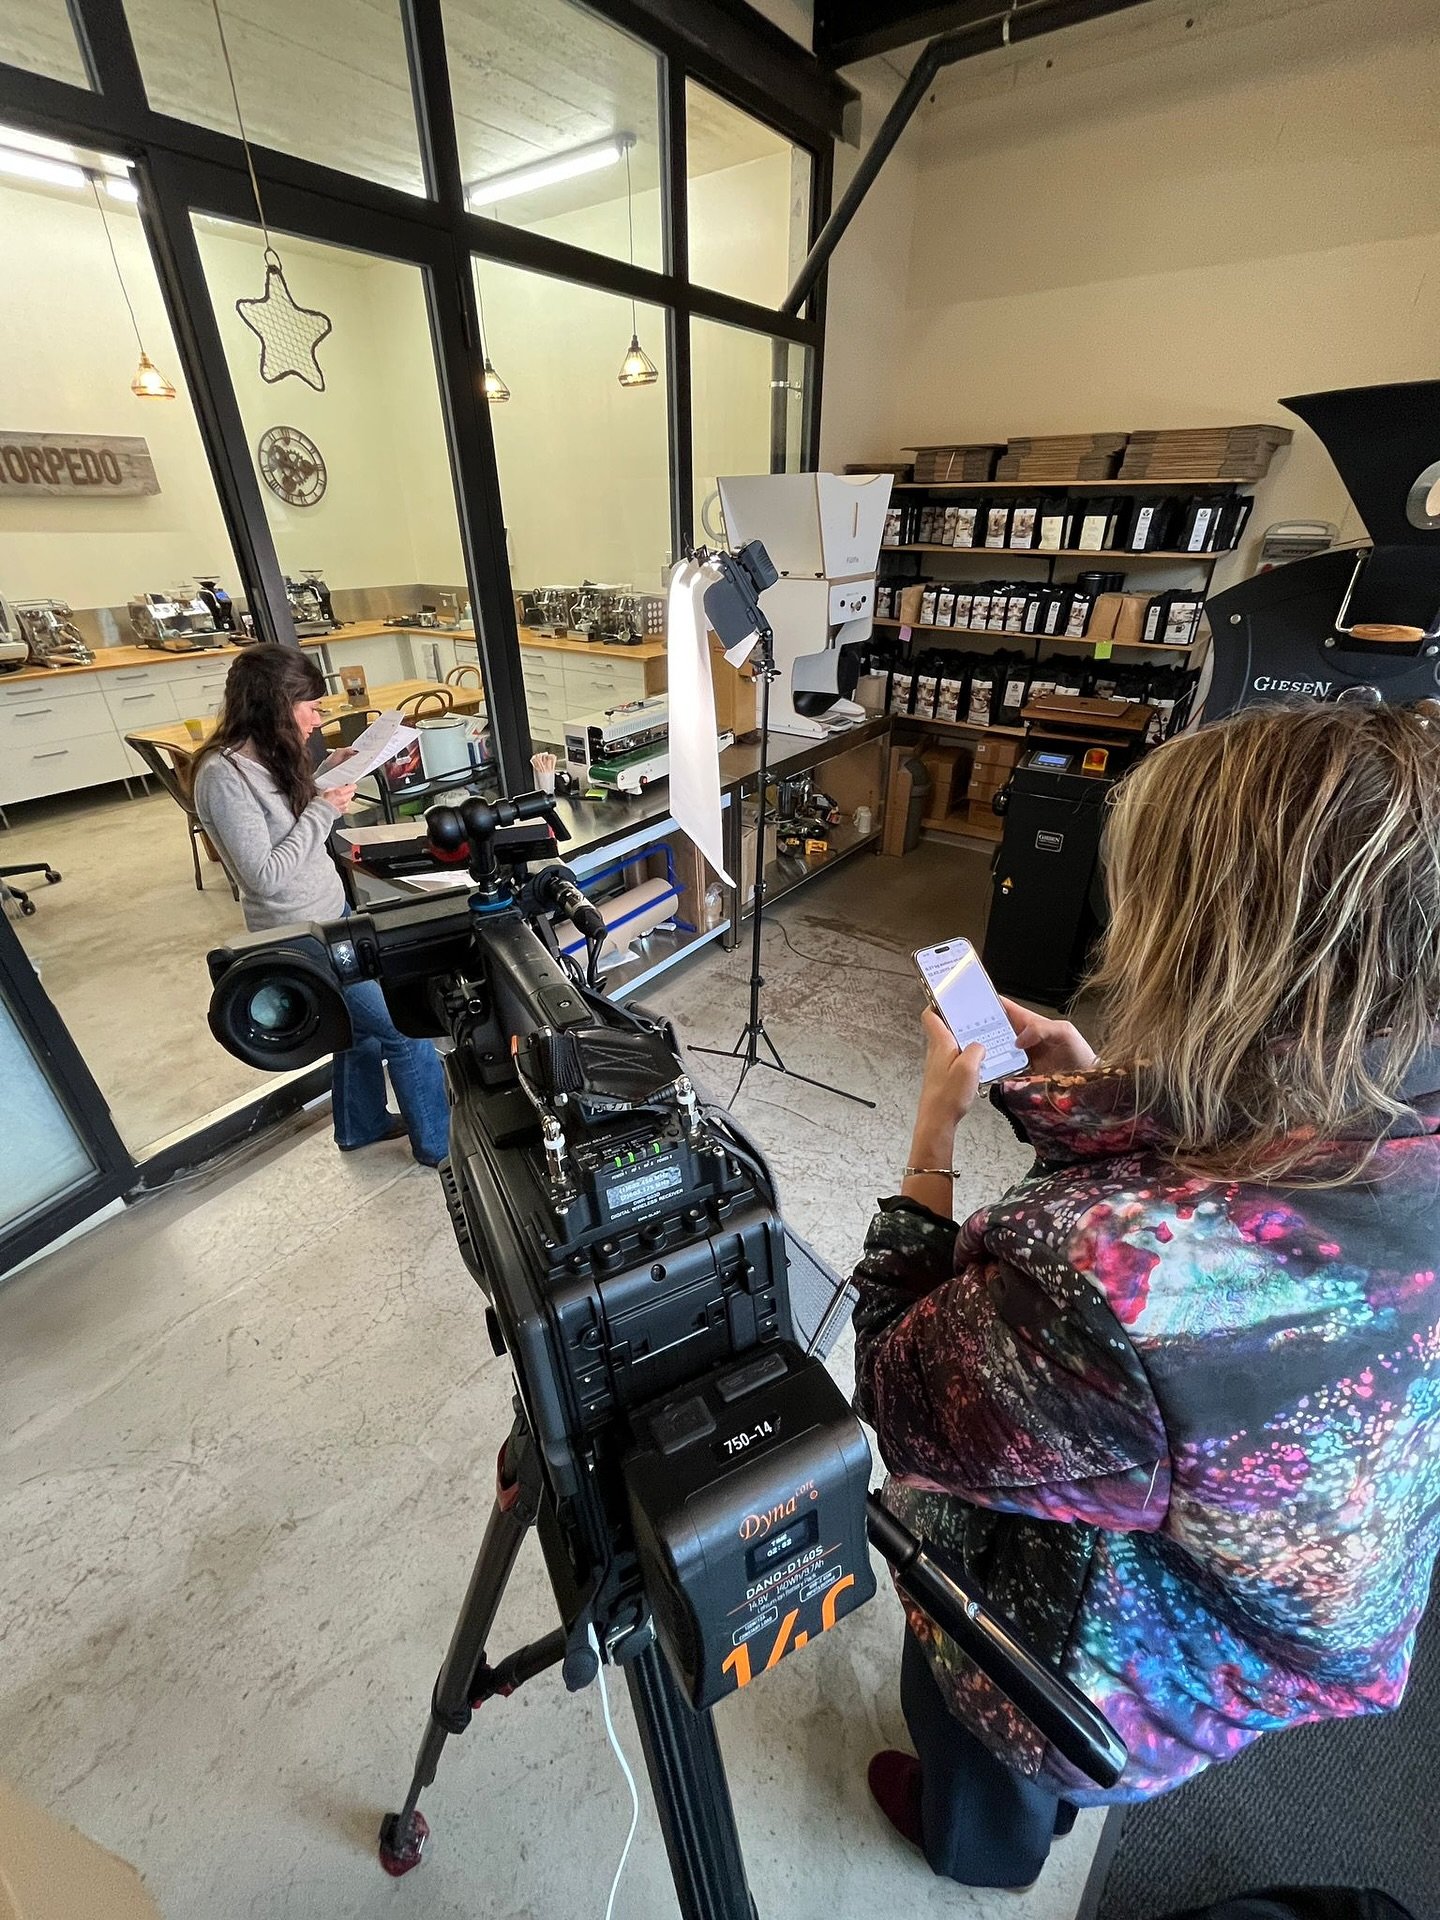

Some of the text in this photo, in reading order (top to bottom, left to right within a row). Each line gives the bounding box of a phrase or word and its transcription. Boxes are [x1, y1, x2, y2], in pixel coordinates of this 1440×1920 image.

[1253, 676, 1332, 697] GIESEN
[610, 1188, 683, 1220] DIGITAL WIRELESS RECEIVER
[723, 1421, 773, 1454] 750-14
[746, 1545, 824, 1600] DANO-D140S
[749, 1593, 769, 1611] 14.8V
